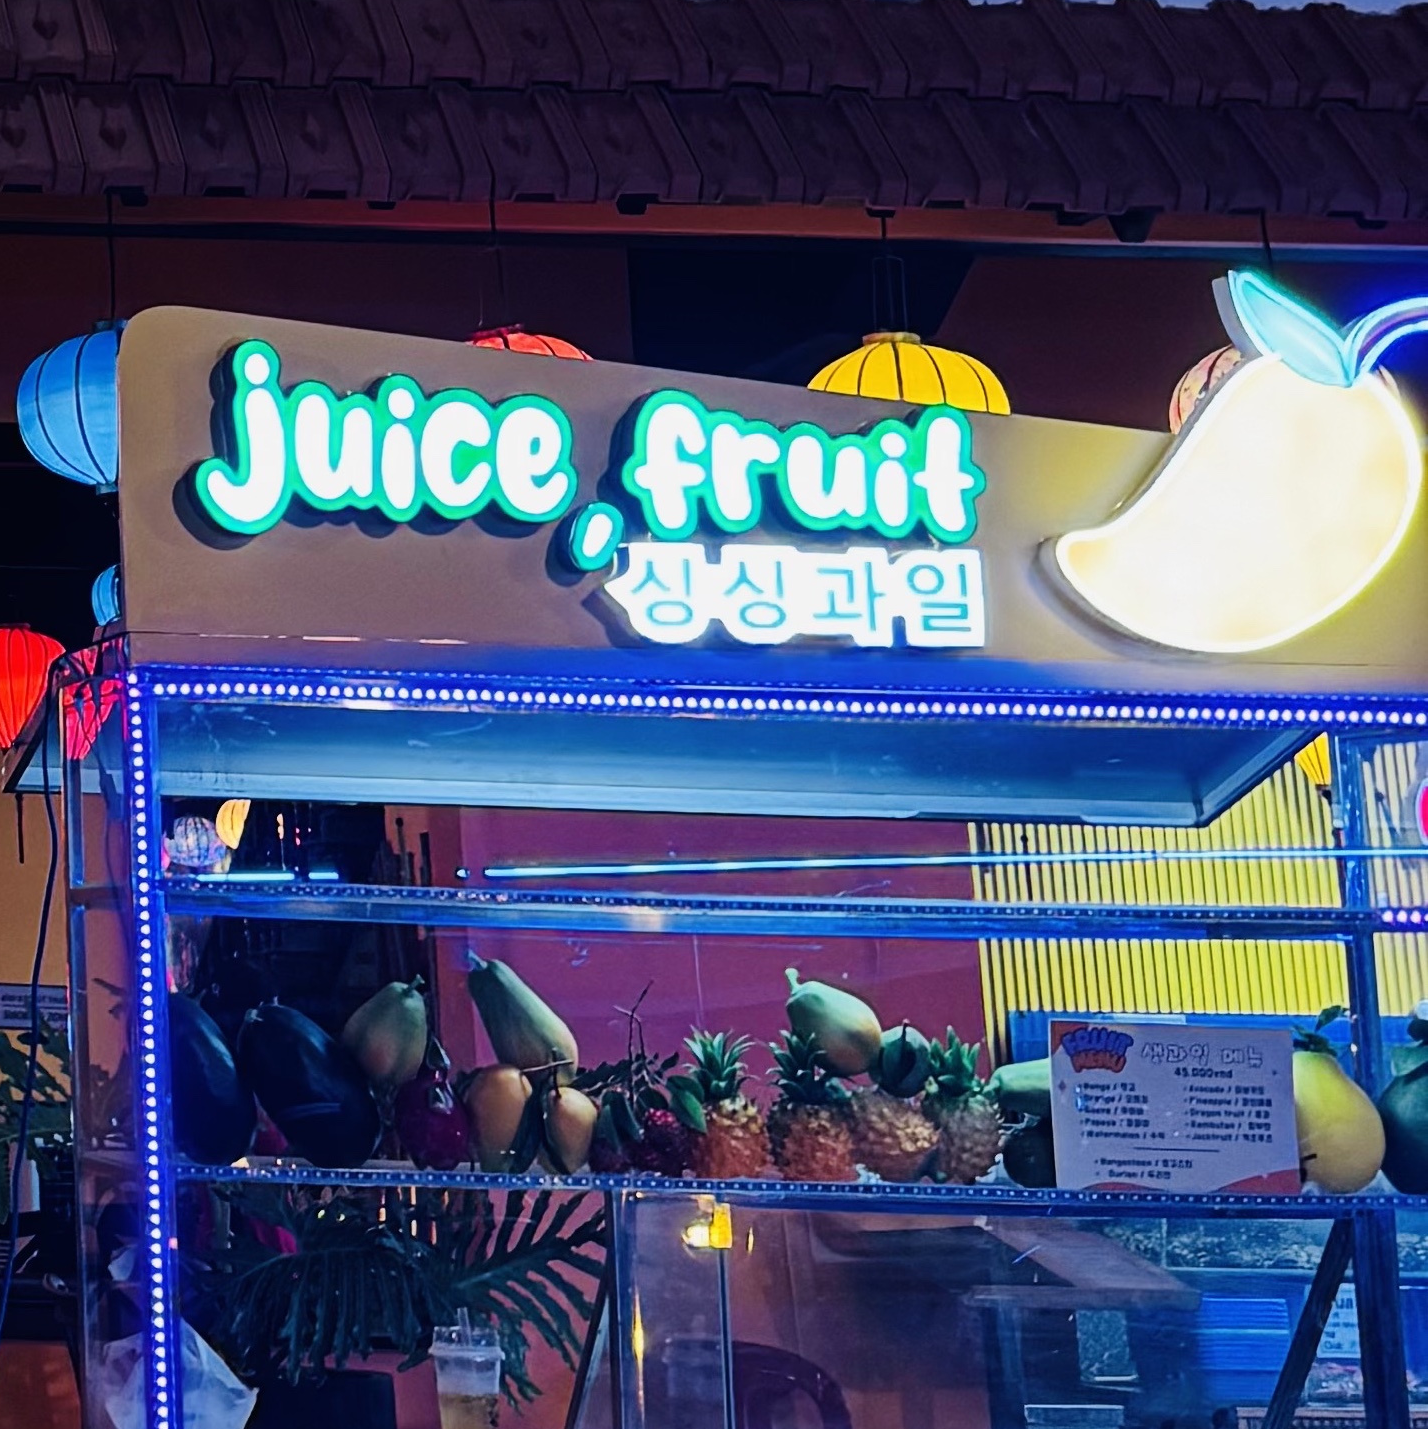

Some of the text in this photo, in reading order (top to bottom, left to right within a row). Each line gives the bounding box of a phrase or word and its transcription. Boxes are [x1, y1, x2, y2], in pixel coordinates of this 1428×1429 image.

[623, 389, 988, 539] fruit
[617, 544, 989, 648] 싱싱과일
[1141, 1042, 1209, 1066] 생과일
